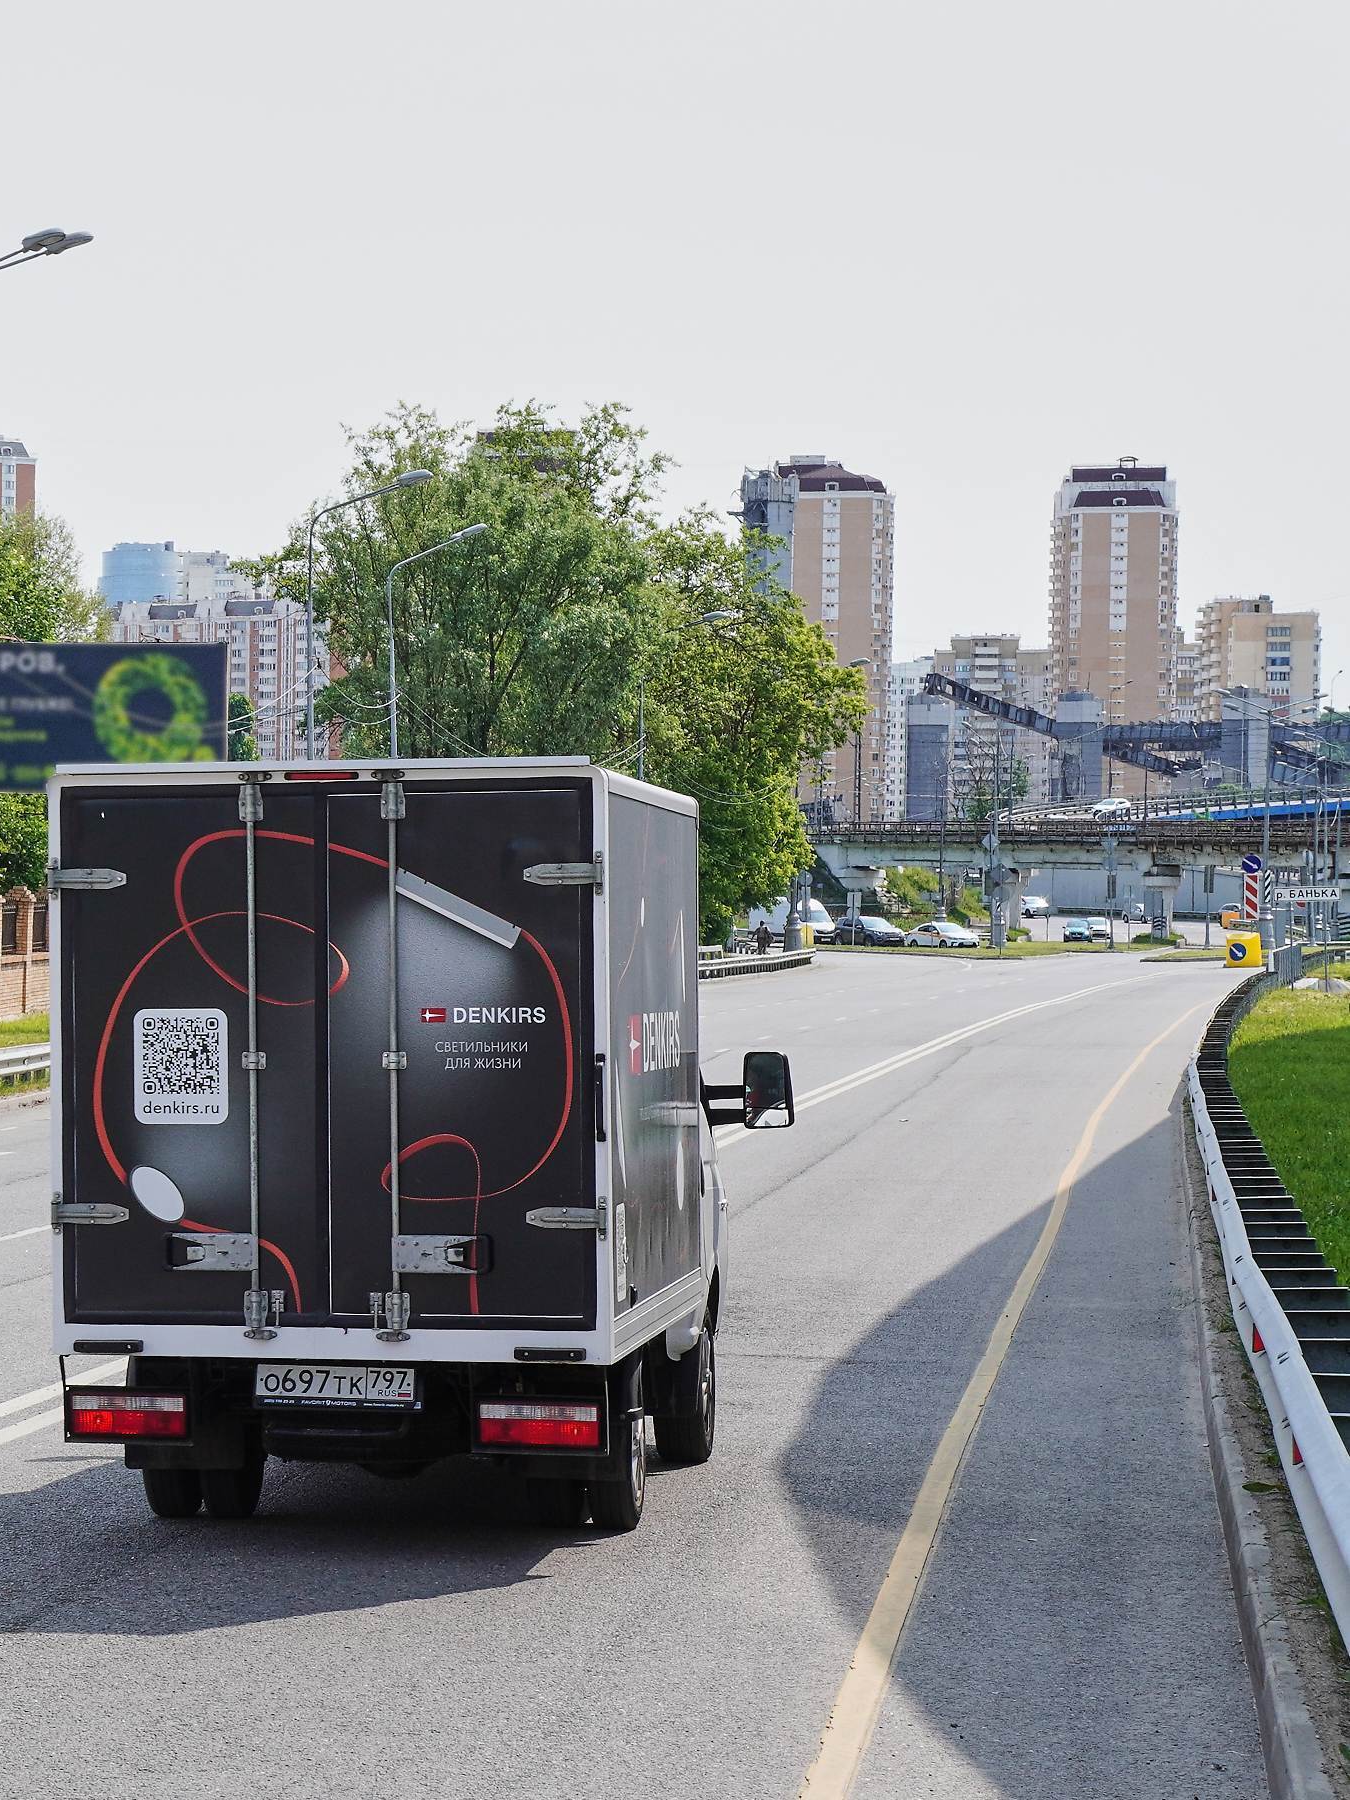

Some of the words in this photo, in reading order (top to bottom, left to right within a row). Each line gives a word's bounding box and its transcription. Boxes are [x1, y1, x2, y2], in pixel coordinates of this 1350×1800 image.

[1289, 889, 1338, 899] БАНЬКА
[453, 1006, 546, 1023] DENKIRS
[435, 1041, 528, 1053] СВЕТИЛЬНИКИ
[642, 1010, 681, 1073] DENKIRS
[445, 1058, 470, 1070] ДЛЯ
[474, 1058, 521, 1069] ЖИЗНИ
[143, 1101, 220, 1114] denkirs.ru
[369, 1370, 409, 1390] 797
[377, 1389, 397, 1397] RUS
